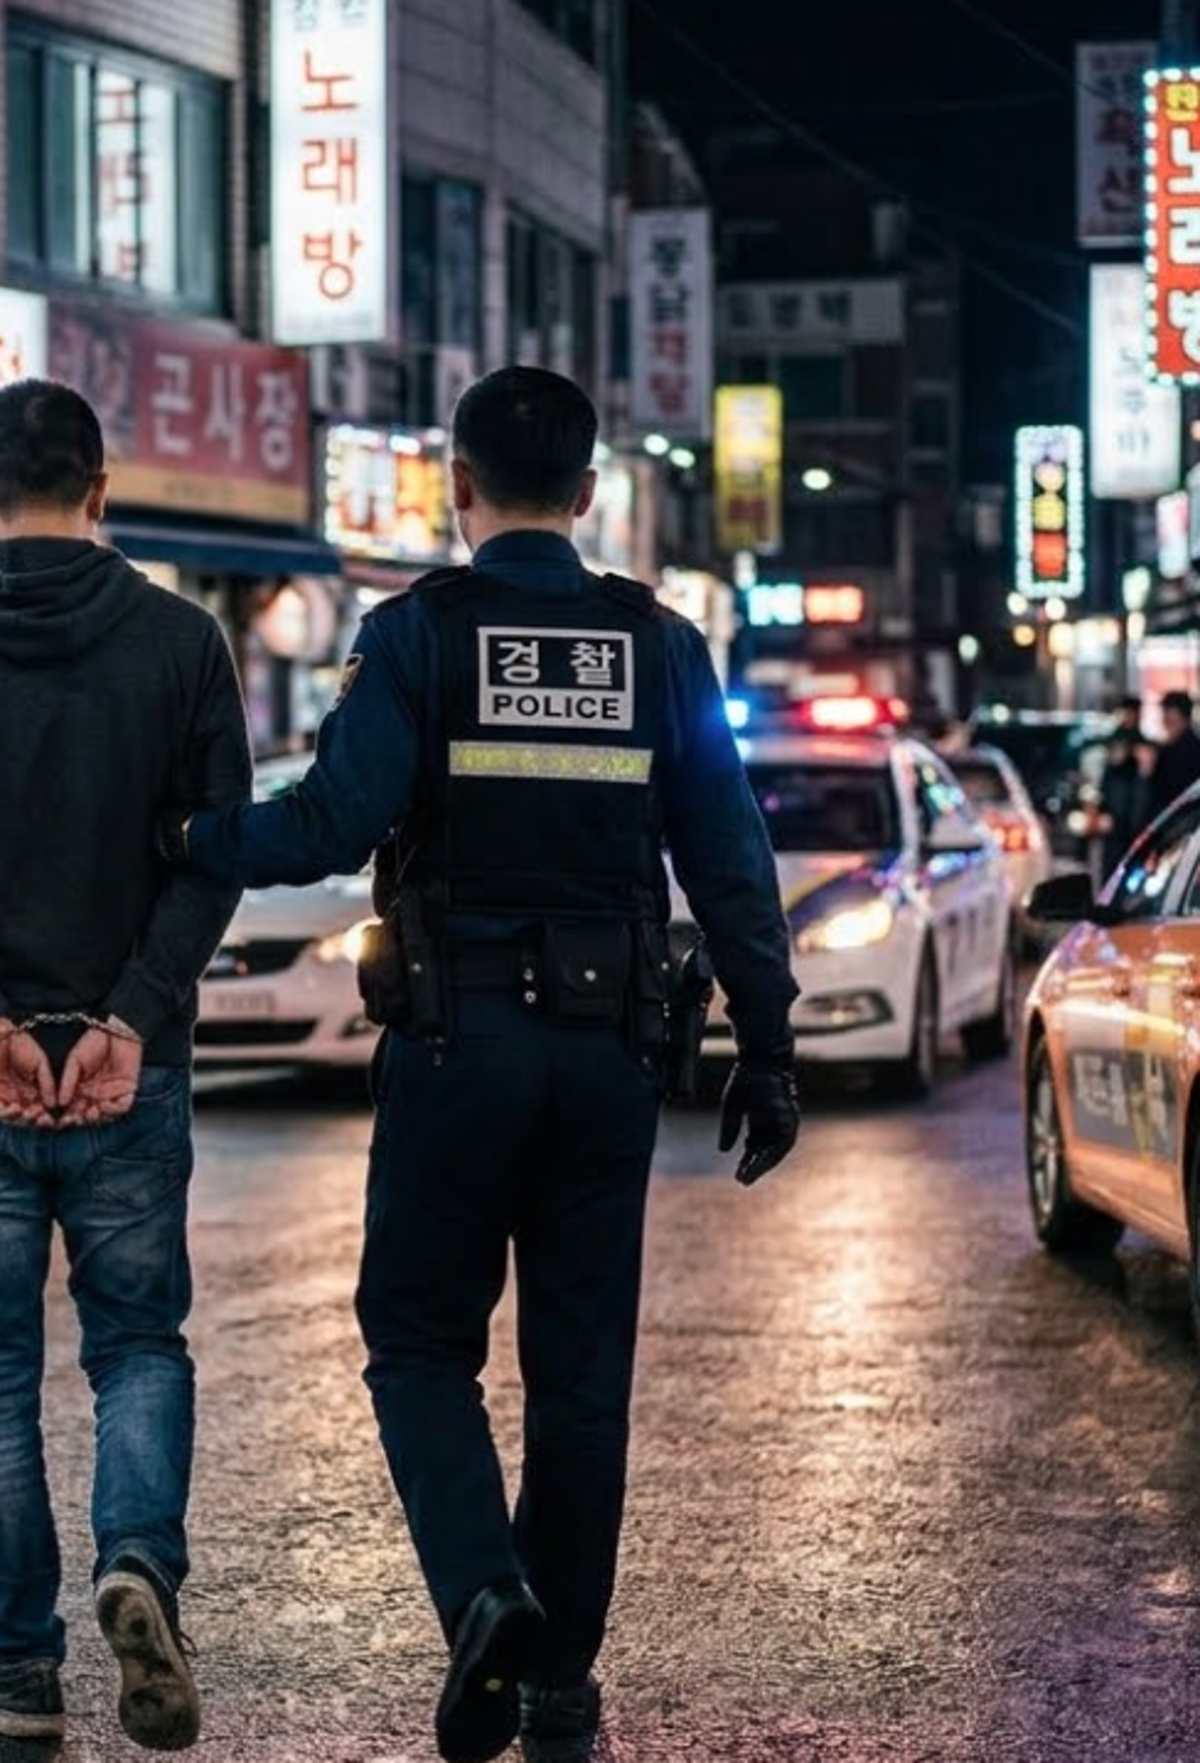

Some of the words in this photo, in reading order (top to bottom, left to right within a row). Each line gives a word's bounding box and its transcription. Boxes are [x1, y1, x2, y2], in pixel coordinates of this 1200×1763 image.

[300, 49, 363, 300] 노래방
[497, 640, 616, 686] 경찰
[492, 693, 621, 721] POLICE
